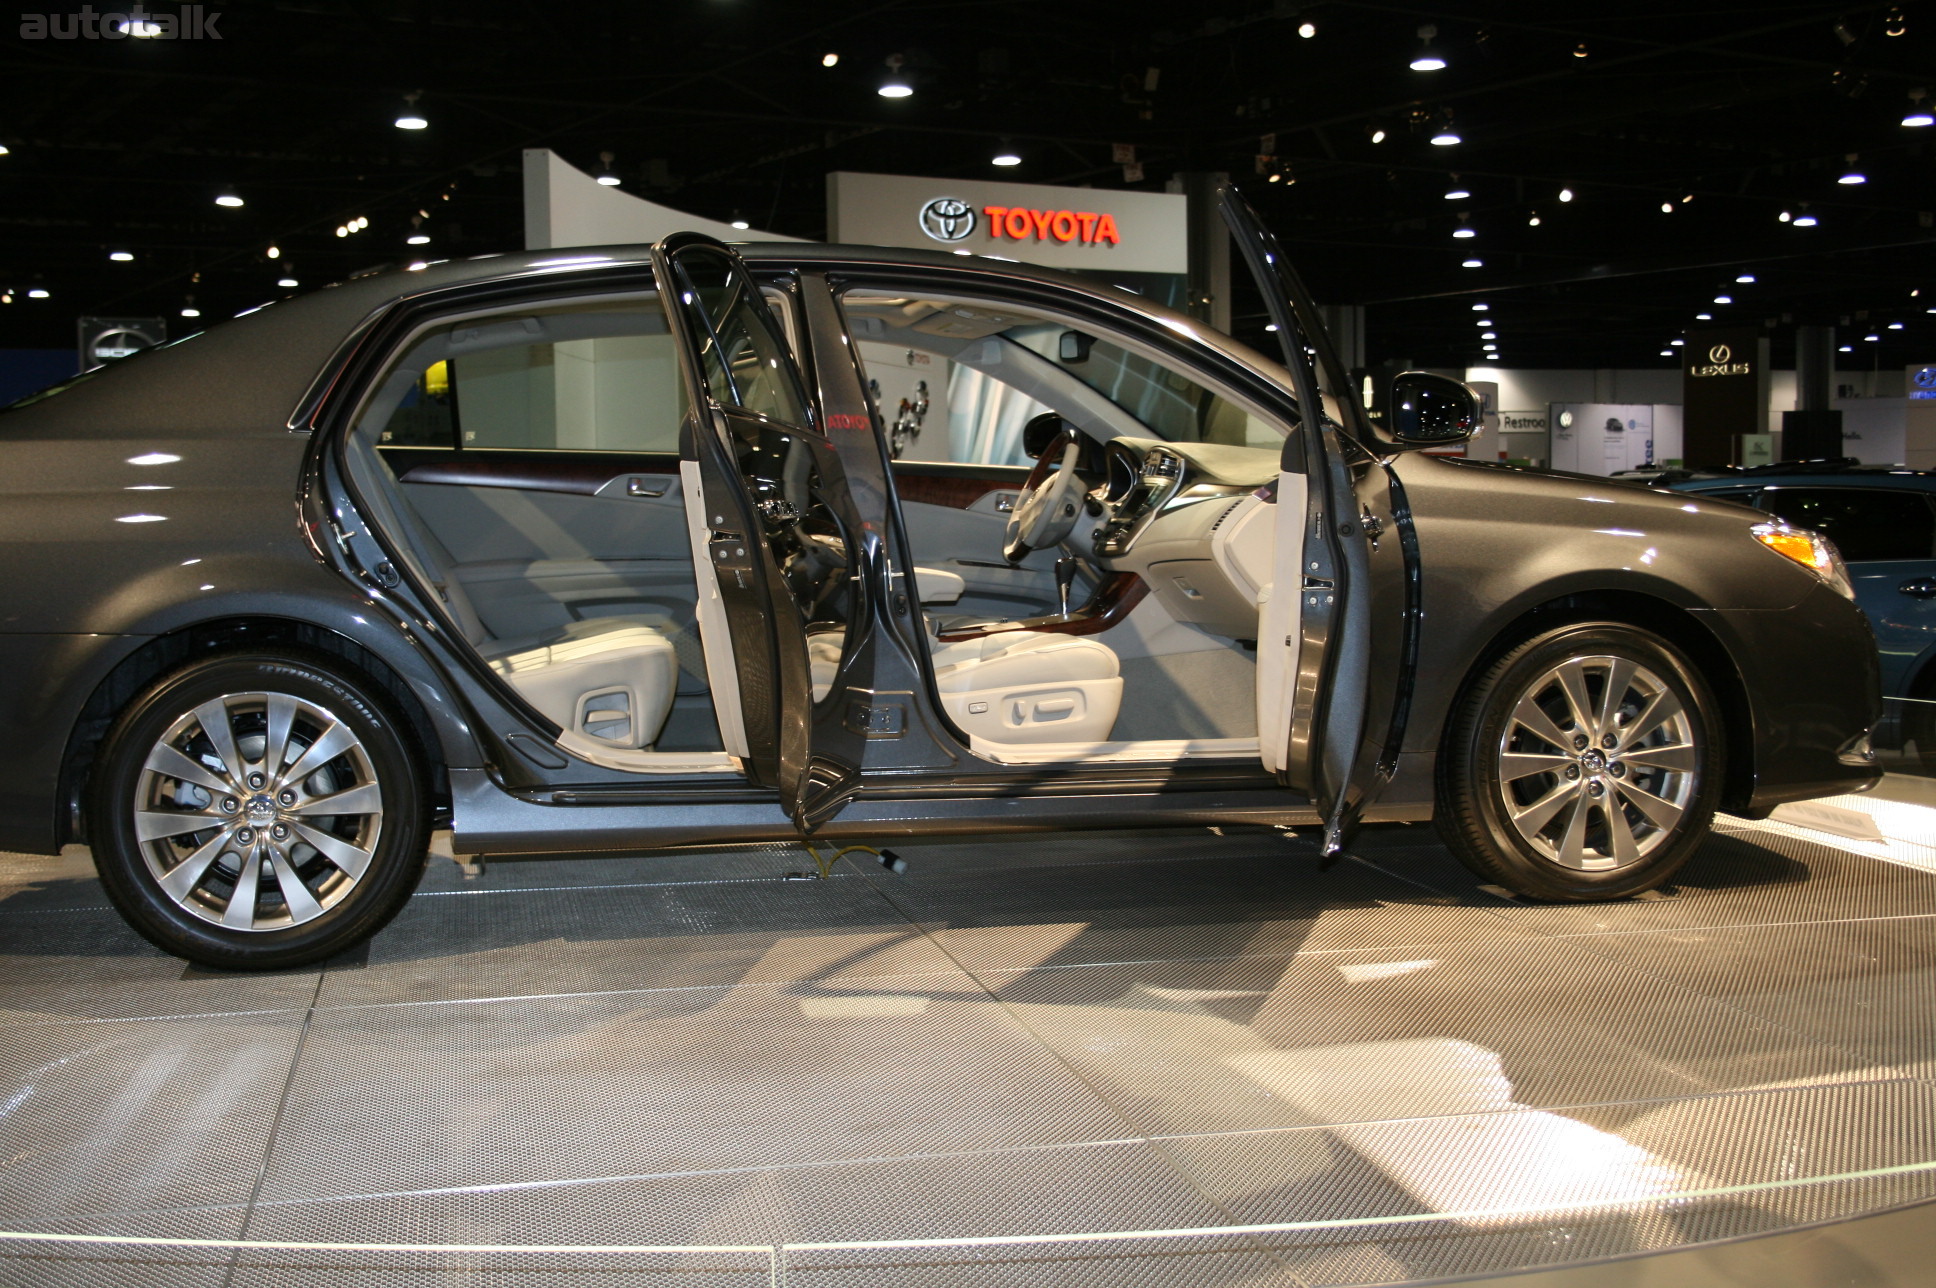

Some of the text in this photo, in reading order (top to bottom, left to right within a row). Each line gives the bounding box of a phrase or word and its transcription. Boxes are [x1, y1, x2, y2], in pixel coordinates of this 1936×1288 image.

[984, 206, 1121, 244] TOYOTA
[1691, 362, 1750, 377] LEXUS
[1504, 416, 1546, 429] Restroo
